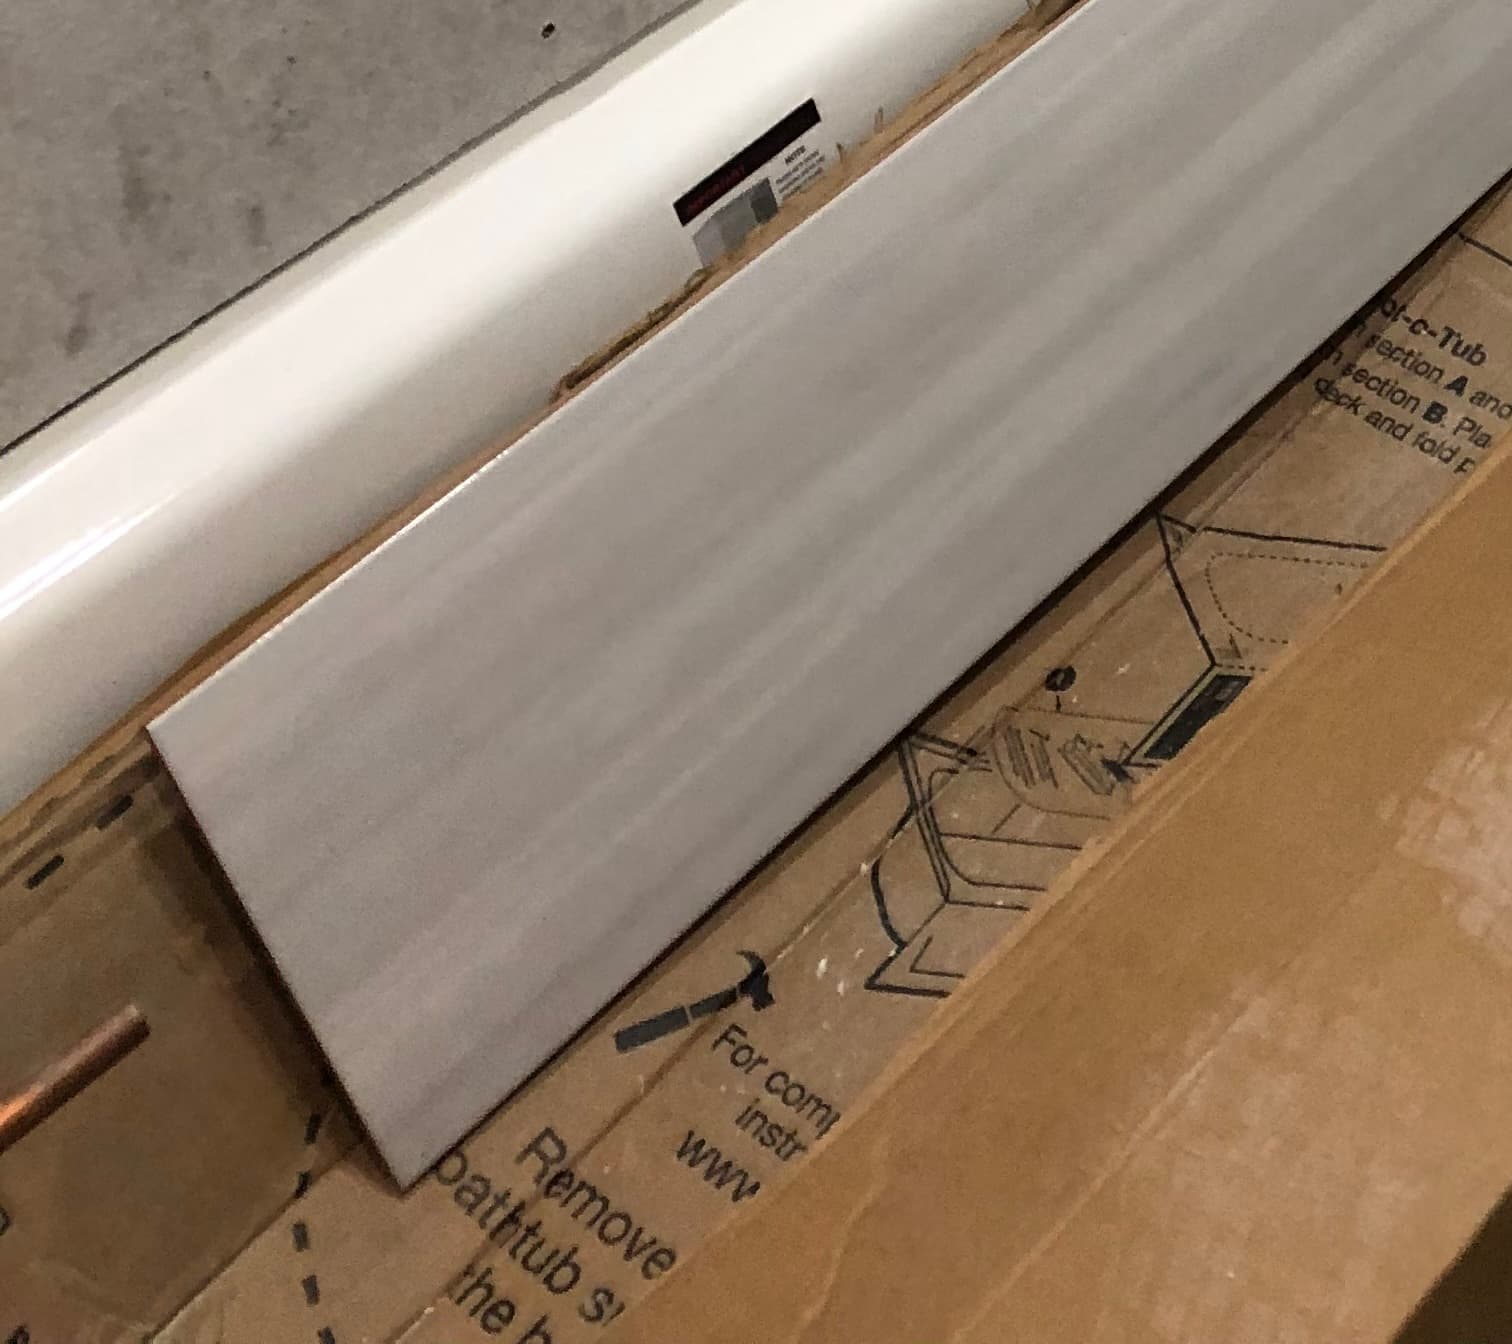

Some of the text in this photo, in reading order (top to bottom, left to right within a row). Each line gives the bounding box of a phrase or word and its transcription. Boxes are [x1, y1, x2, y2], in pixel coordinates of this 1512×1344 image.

[1341, 362, 1421, 414] section
[1452, 416, 1493, 450] Pla
[1444, 375, 1469, 398] A
[1364, 410, 1415, 442] and
[1412, 430, 1461, 465] fold
[711, 1023, 769, 1075] For
[735, 1097, 809, 1162] instr
[514, 1125, 678, 1281] Remove
